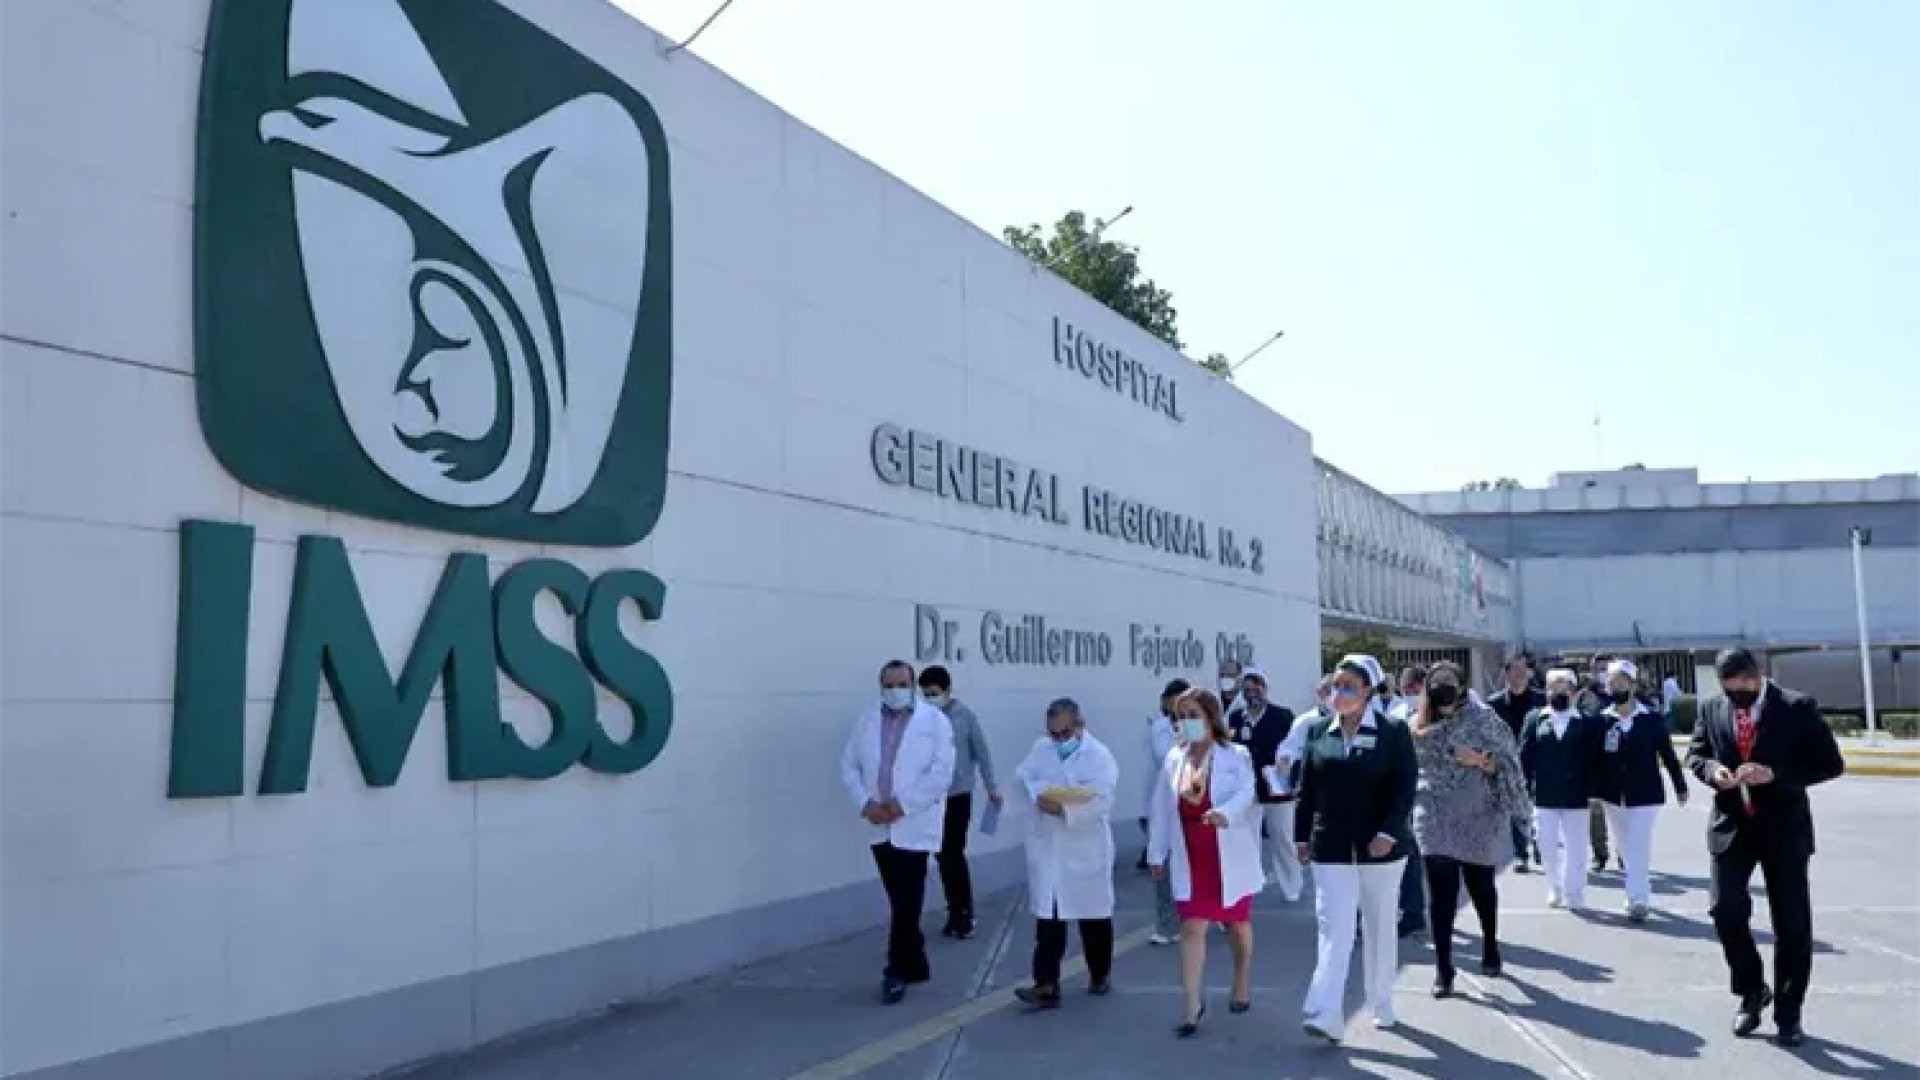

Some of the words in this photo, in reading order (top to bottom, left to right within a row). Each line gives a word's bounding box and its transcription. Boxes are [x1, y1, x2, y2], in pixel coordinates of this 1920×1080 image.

[1052, 316, 1185, 423] HOSPITAL
[870, 422, 1069, 526] GENERAL
[1083, 486, 1212, 562] REGIONAL
[1249, 536, 1265, 576] 2
[168, 519, 674, 799] IMSS
[914, 603, 963, 662] Dr.
[980, 609, 1112, 667] Guillermo
[1129, 622, 1204, 676] Fajardo
